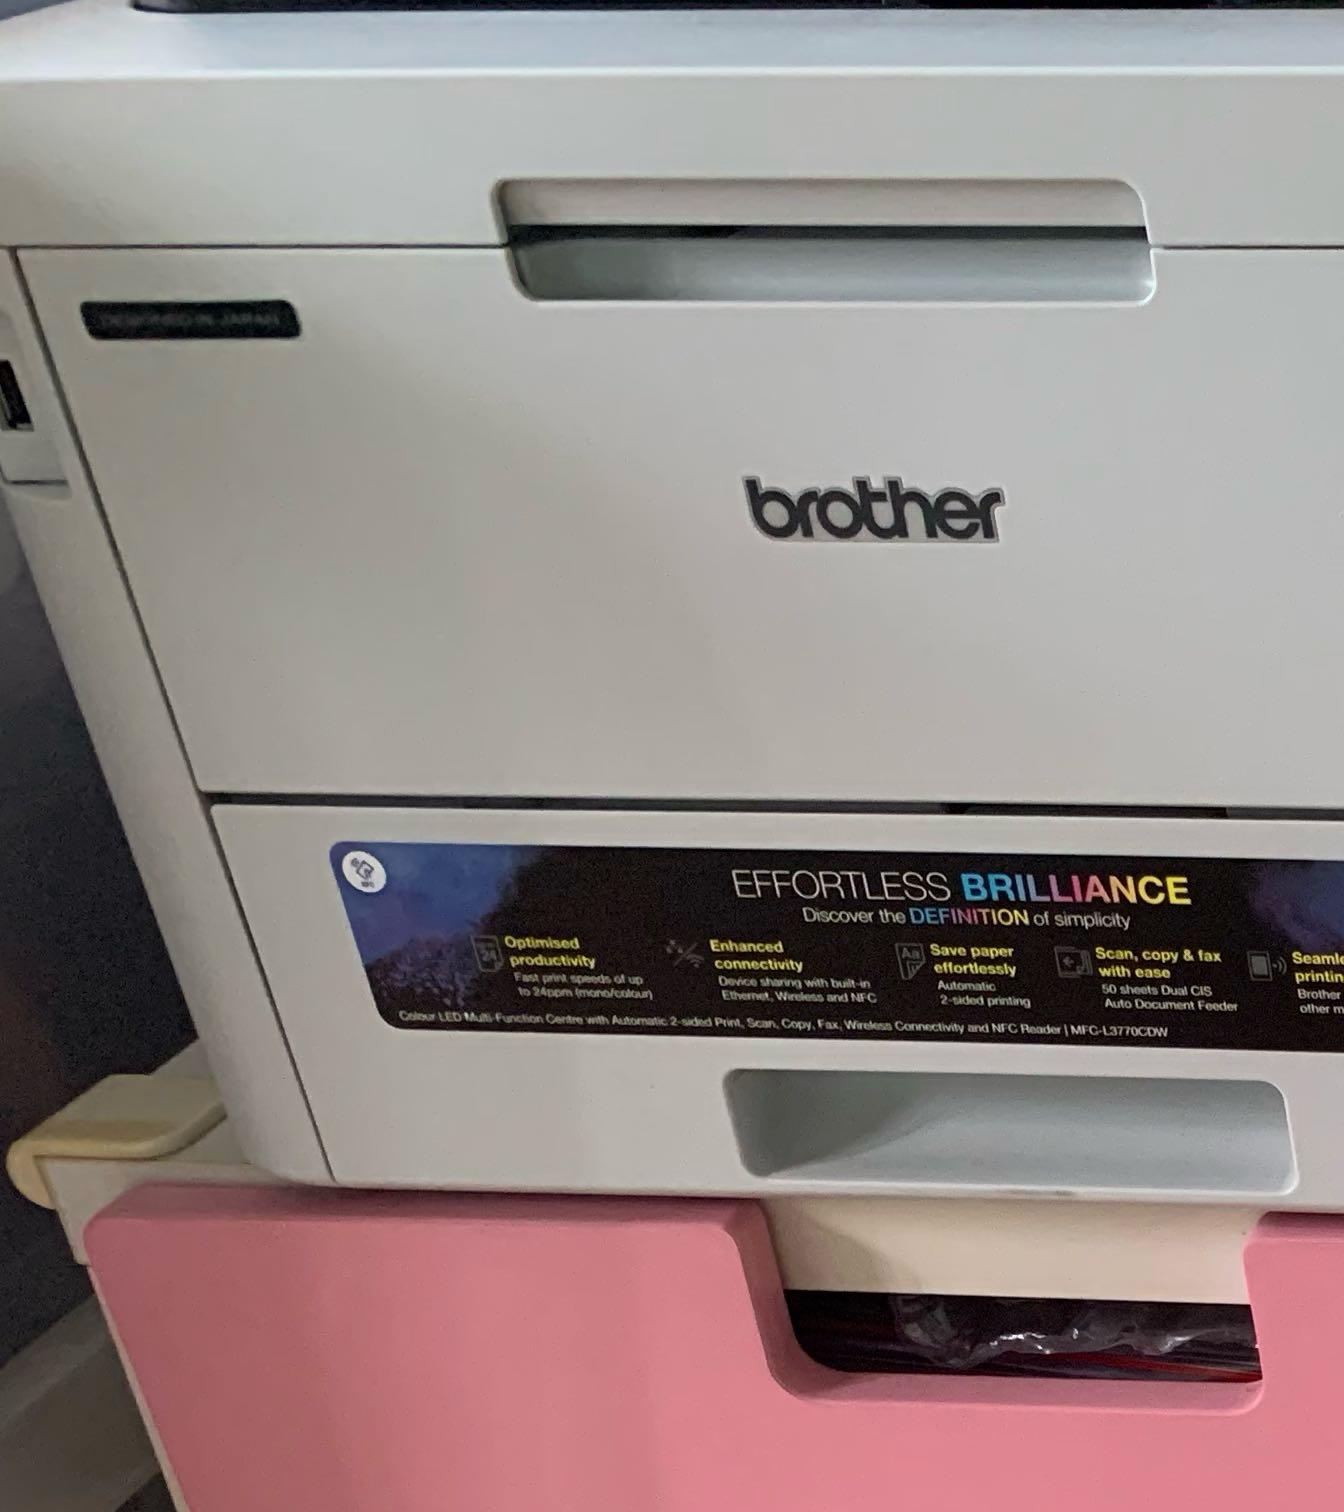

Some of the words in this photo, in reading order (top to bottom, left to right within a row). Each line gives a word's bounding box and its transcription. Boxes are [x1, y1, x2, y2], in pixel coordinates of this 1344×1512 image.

[743, 477, 1003, 541] brother
[731, 869, 951, 901] EFFORTLESS
[960, 873, 1192, 905] BRILLIANCE
[802, 906, 874, 924] Discover
[878, 908, 906, 925] the
[908, 907, 1030, 926] DEFINITION
[1033, 910, 1050, 927] of
[1054, 911, 1131, 931] simplicity
[504, 935, 580, 950] Optimised
[709, 939, 785, 953] Enhanced
[929, 943, 967, 956] Save
[970, 946, 1014, 959] paper
[1095, 946, 1139, 962] Scan,
[1142, 950, 1179, 964] copy
[1183, 949, 1194, 962] &
[1198, 949, 1222, 963] fax
[509, 954, 596, 970] productivity
[714, 957, 803, 973] connectivity
[934, 962, 1017, 978] effortlessly
[1098, 965, 1131, 978] with
[1135, 967, 1171, 979] ease
[514, 972, 539, 983] Fast
[542, 972, 567, 984] print
[570, 973, 612, 985] speeds
[628, 975, 643, 986] up
[718, 975, 758, 988] Device
[759, 976, 802, 990] sharing
[804, 978, 829, 988] with
[830, 978, 871, 989] built-in
[937, 980, 996, 991] Automatic
[518, 986, 531, 997] to
[775, 991, 824, 1003] Wireless
[826, 992, 849, 1003] and
[850, 992, 878, 1004] NFC
[1101, 983, 1117, 995] 50
[1119, 984, 1159, 996] sheets
[1160, 985, 1188, 997] Dual
[1190, 985, 1213, 997] CIS
[1297, 988, 1341, 1001] Brother
[940, 994, 985, 1007] 2-sided
[987, 995, 1032, 1009] printing
[1104, 998, 1132, 1010] Auto
[1134, 999, 1195, 1011] Document
[1197, 1000, 1238, 1012] Feeder
[1300, 1004, 1330, 1014] other
[438, 1011, 462, 1023] LED
[545, 1013, 583, 1025] Centre
[586, 1014, 610, 1025] with
[612, 1014, 667, 1027] Automatic
[670, 1016, 713, 1027] 2-sided
[843, 1019, 893, 1032] Wireless
[894, 1020, 964, 1035] Connectivity
[967, 1022, 990, 1033] and
[991, 1023, 1018, 1034] NFC
[1020, 1023, 1061, 1035] Reader
[1070, 1024, 1169, 1038] MFC-L3770CDW
